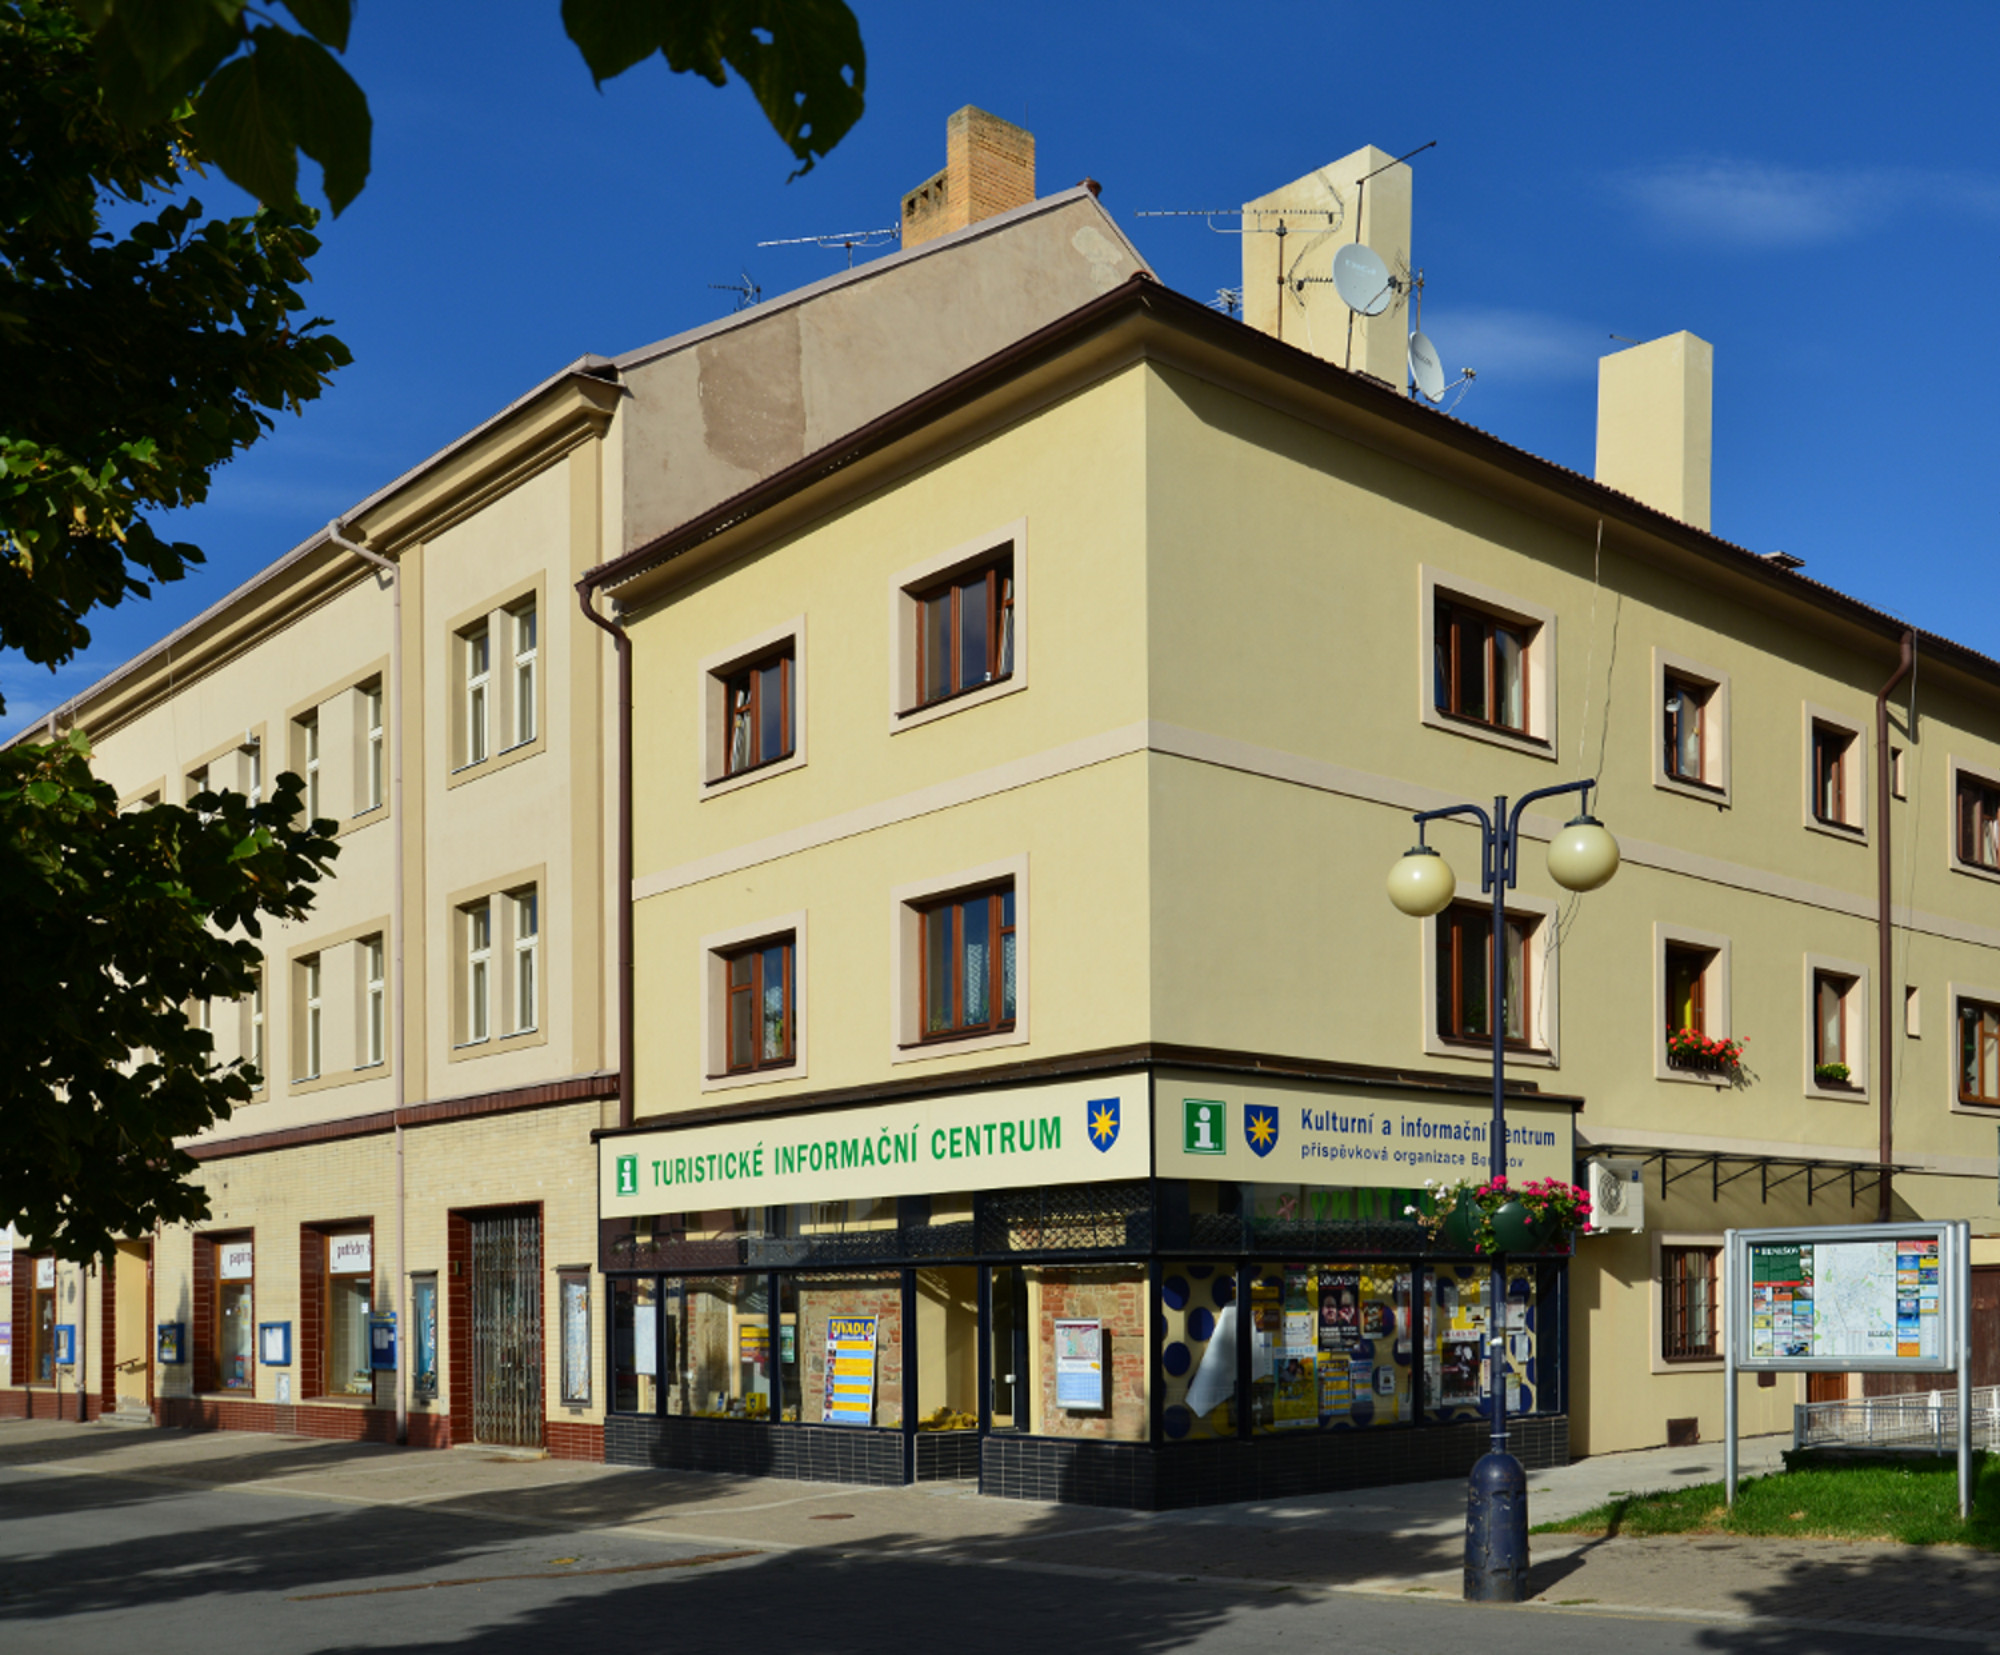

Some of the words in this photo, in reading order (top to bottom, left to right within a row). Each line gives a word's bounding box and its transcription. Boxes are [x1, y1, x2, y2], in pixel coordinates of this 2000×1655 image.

[1301, 1108, 1375, 1134] Kulturní
[1381, 1119, 1391, 1135] a
[1401, 1115, 1487, 1142] informační
[1505, 1126, 1555, 1146] entrum
[652, 1141, 763, 1186] TURISTICKÉ
[775, 1123, 920, 1175] INFORMAČNÍ
[931, 1116, 1061, 1160] CENTRUM
[1393, 1149, 1465, 1166] organizace
